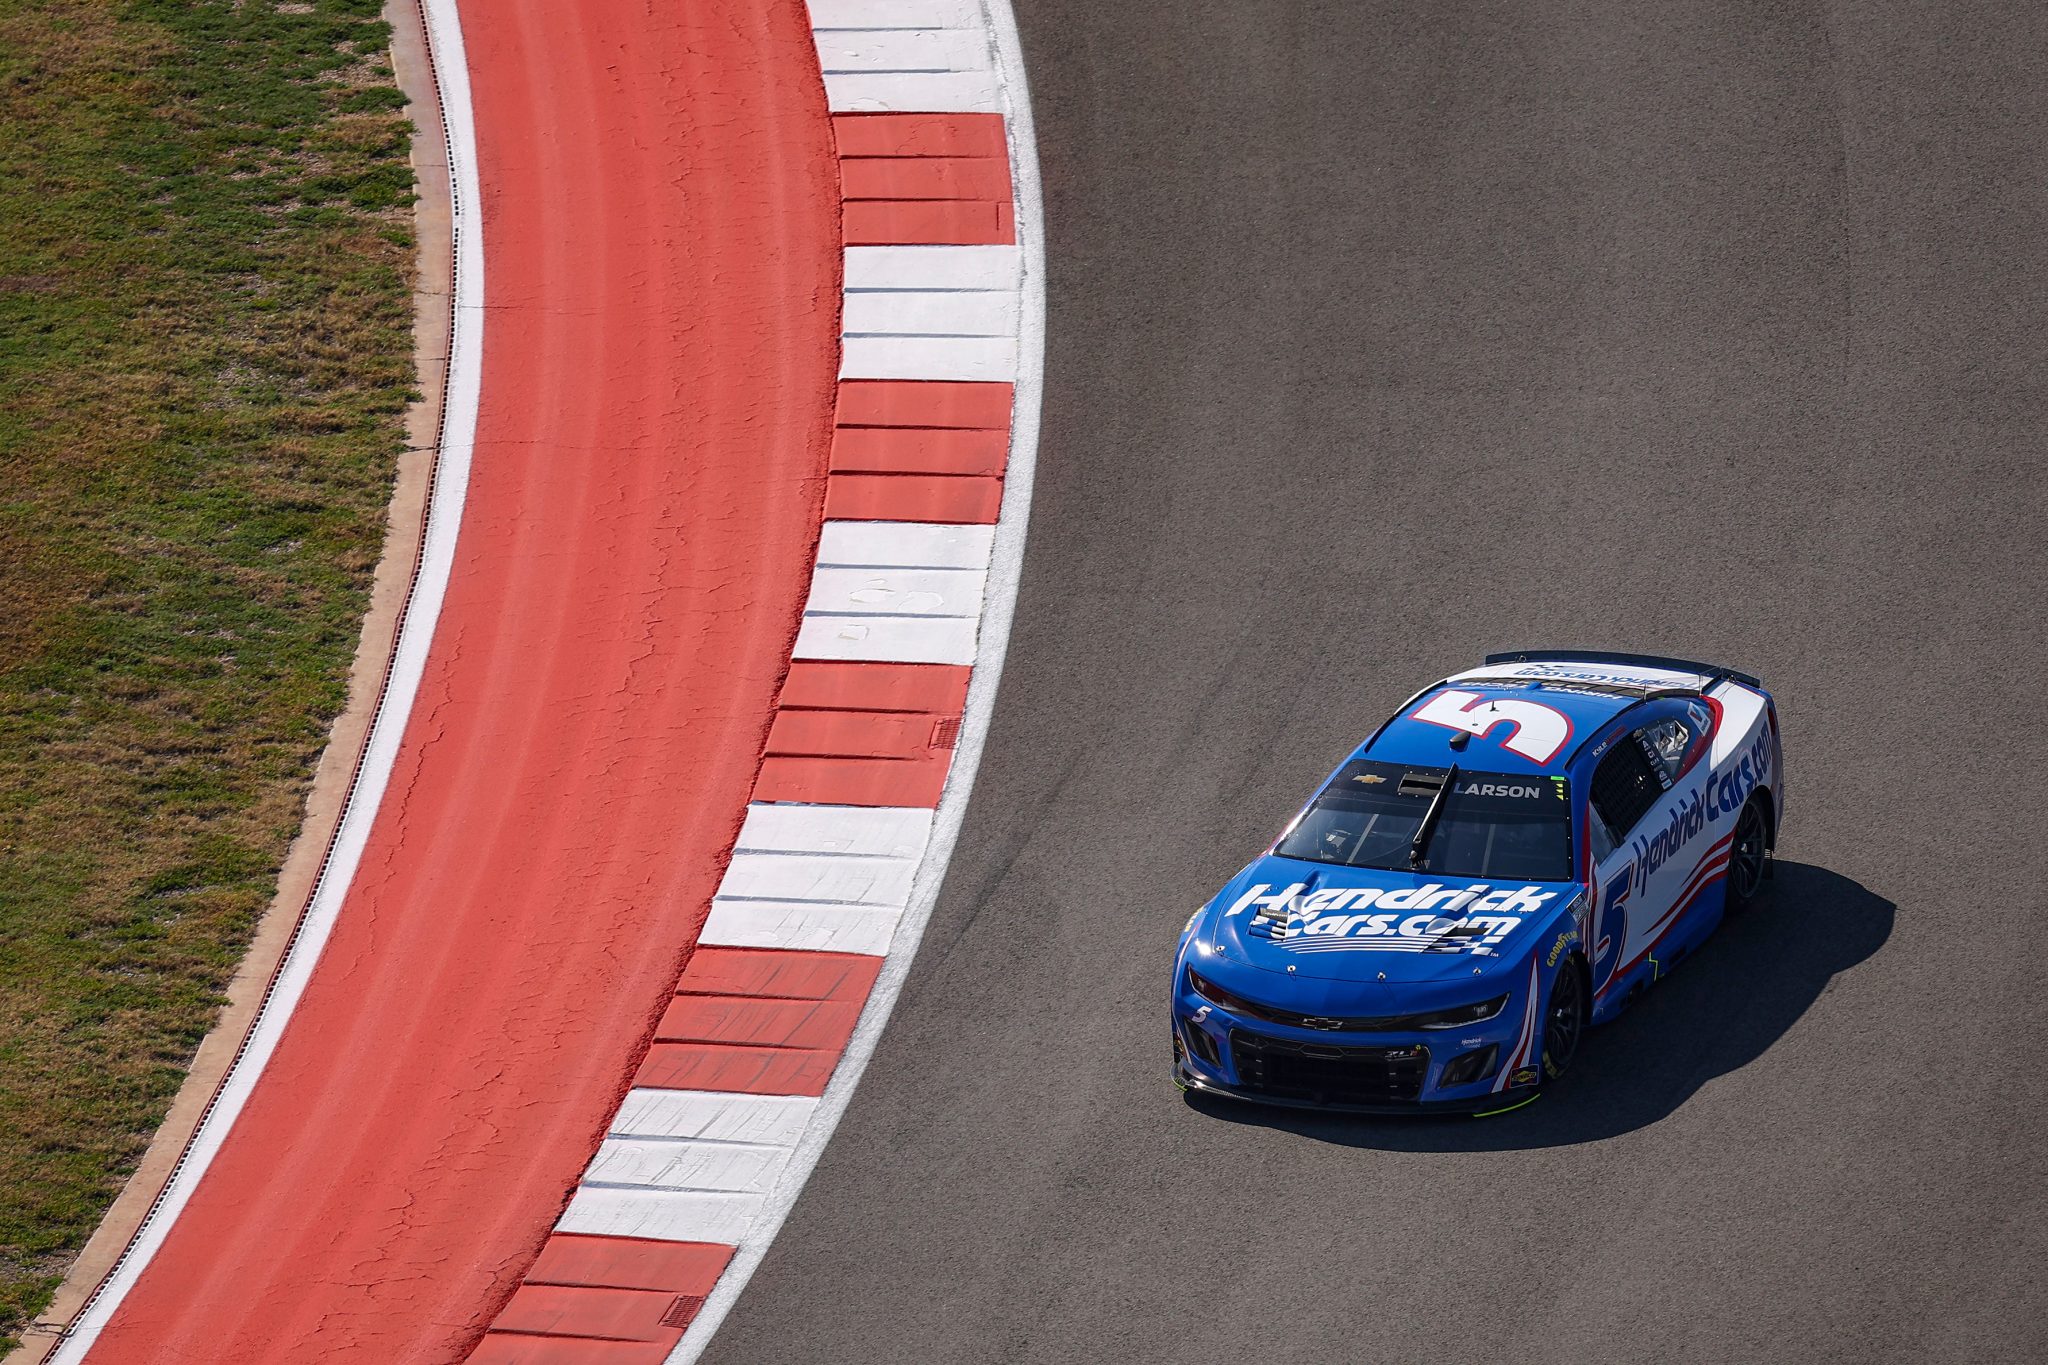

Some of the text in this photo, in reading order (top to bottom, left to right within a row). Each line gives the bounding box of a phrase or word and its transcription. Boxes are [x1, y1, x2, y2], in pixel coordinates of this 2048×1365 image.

[1408, 689, 1574, 768] 5
[1453, 782, 1540, 799] LARSON
[1632, 721, 1773, 898] HendrickCars.com
[1224, 882, 1557, 917] Hendrick
[1270, 912, 1523, 940] Cars.com
[1593, 861, 1635, 1000] 5
[1546, 930, 1579, 968] GOODYEAR
[1191, 1006, 1213, 1024] 5
